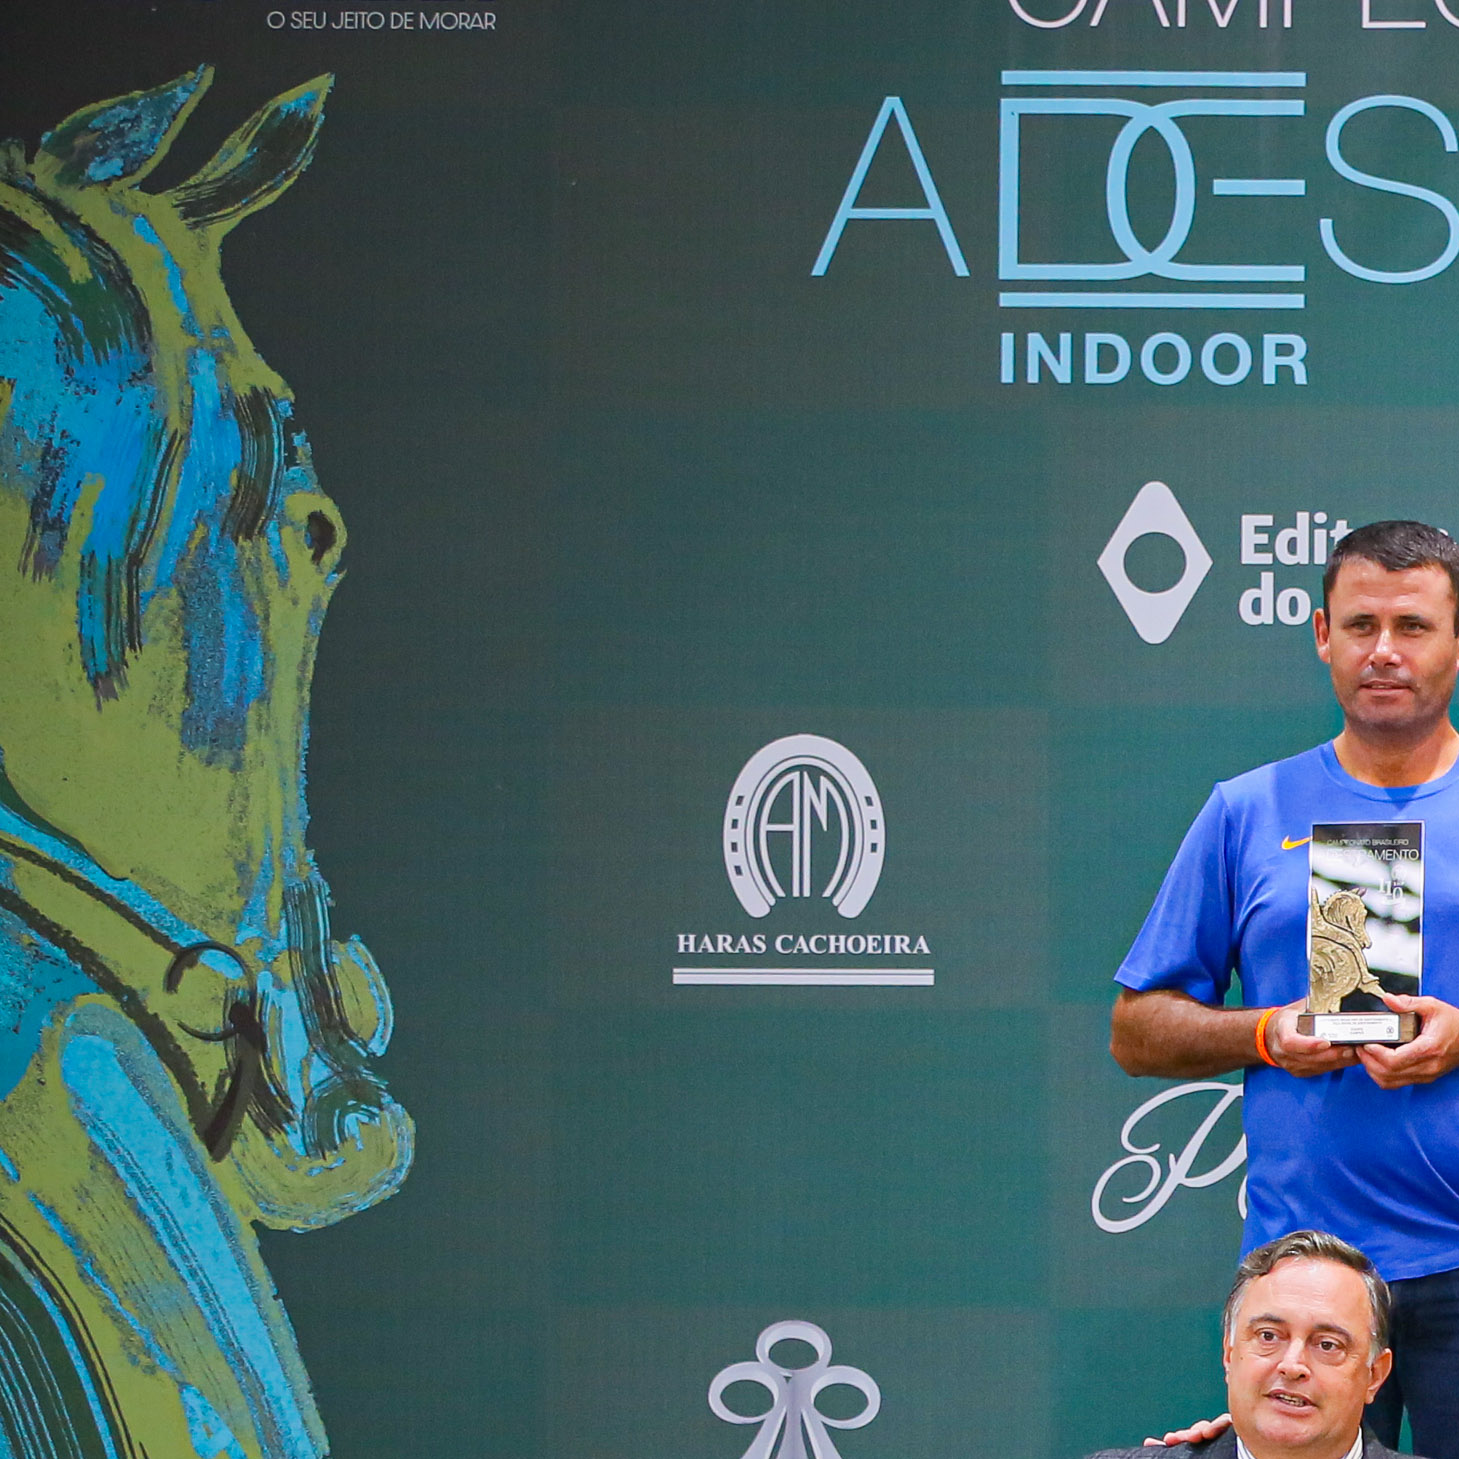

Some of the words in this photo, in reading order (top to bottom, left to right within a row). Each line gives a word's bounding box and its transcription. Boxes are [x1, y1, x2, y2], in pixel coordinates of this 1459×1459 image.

[267, 11, 286, 29] O
[290, 11, 327, 29] SEU
[331, 11, 386, 30] JEITO
[390, 12, 414, 30] DE
[419, 12, 497, 30] MORAR
[1000, 331, 1308, 386] INDOOR
[1239, 571, 1311, 625] do
[677, 933, 767, 954] HARAS
[774, 933, 931, 955] CACHOEIRA
